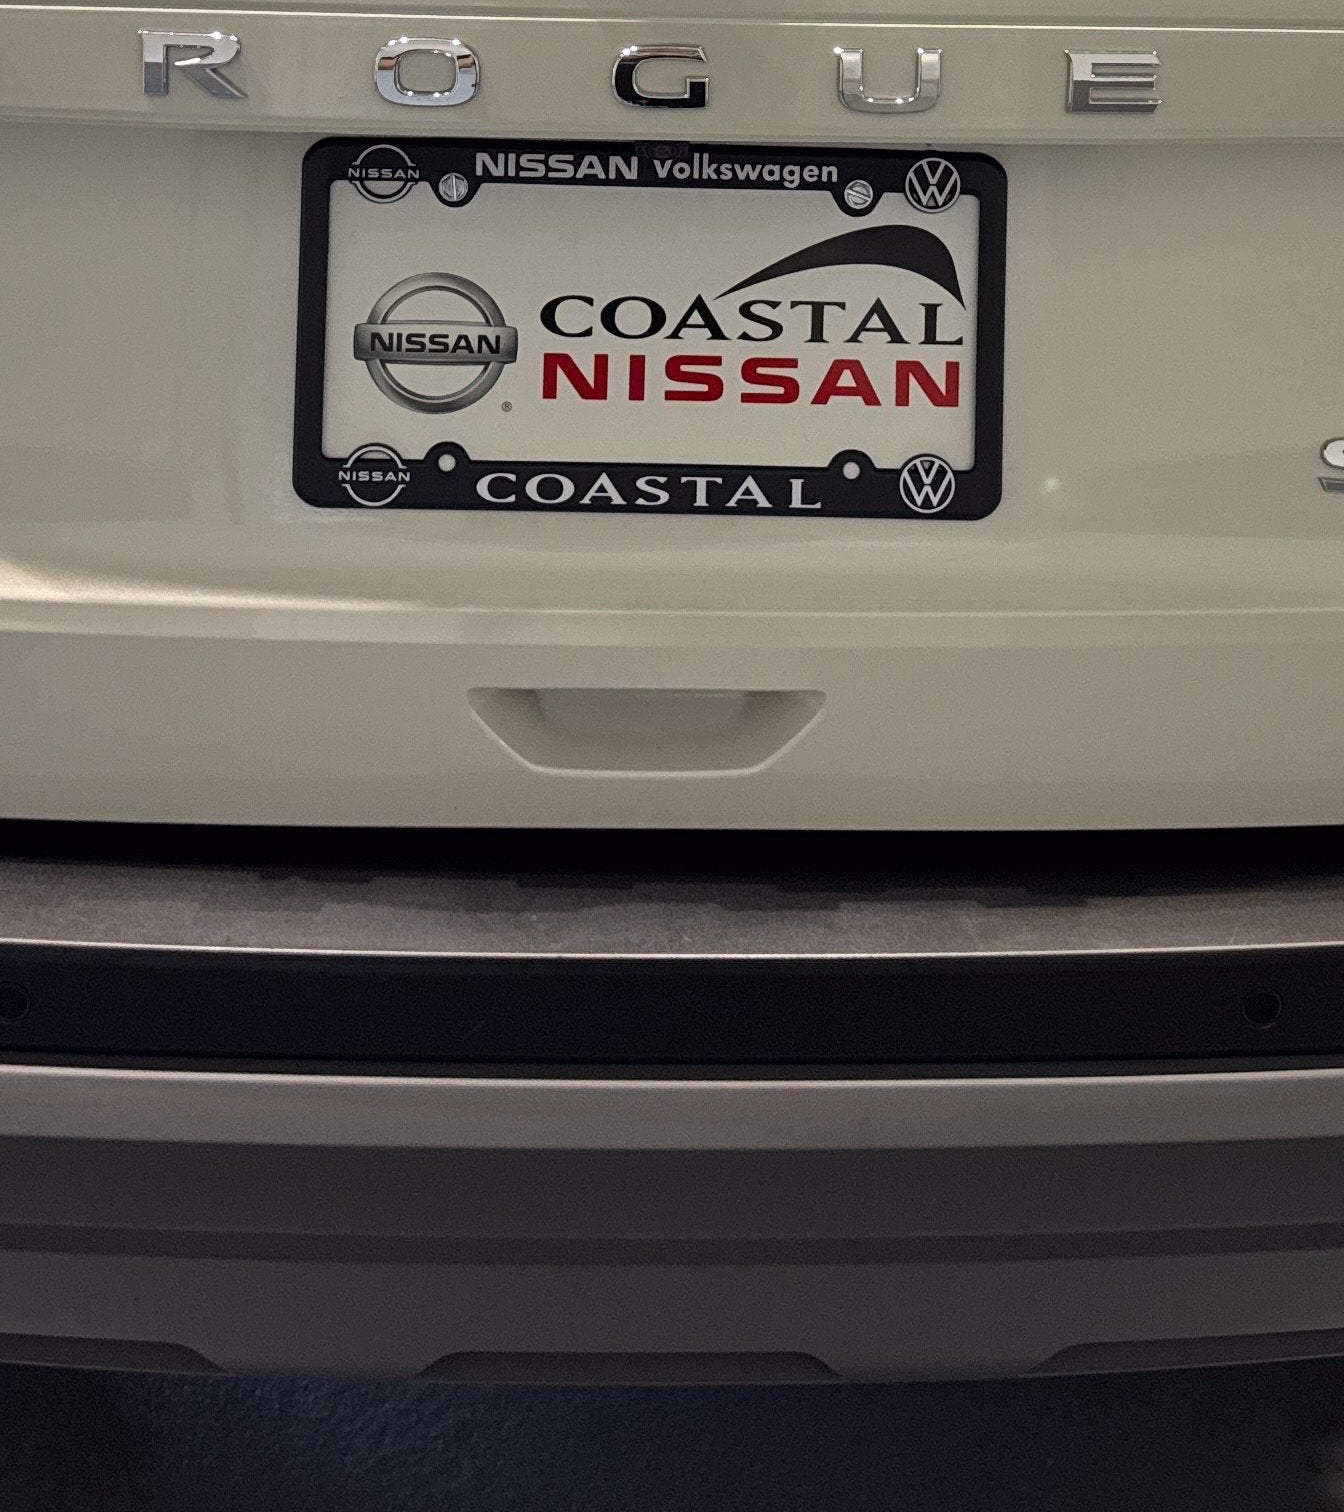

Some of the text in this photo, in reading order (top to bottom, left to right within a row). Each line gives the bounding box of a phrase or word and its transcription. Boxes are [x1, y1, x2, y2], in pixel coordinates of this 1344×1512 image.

[136, 29, 1164, 114] ROGUE
[347, 167, 420, 180] NISSAN
[475, 152, 639, 180] NISSAN
[540, 294, 964, 346] COASTAL
[370, 332, 501, 355] NISSAN
[542, 352, 960, 407] NISSAN
[338, 470, 411, 483] NISSAN
[476, 472, 822, 509] COASTAL
